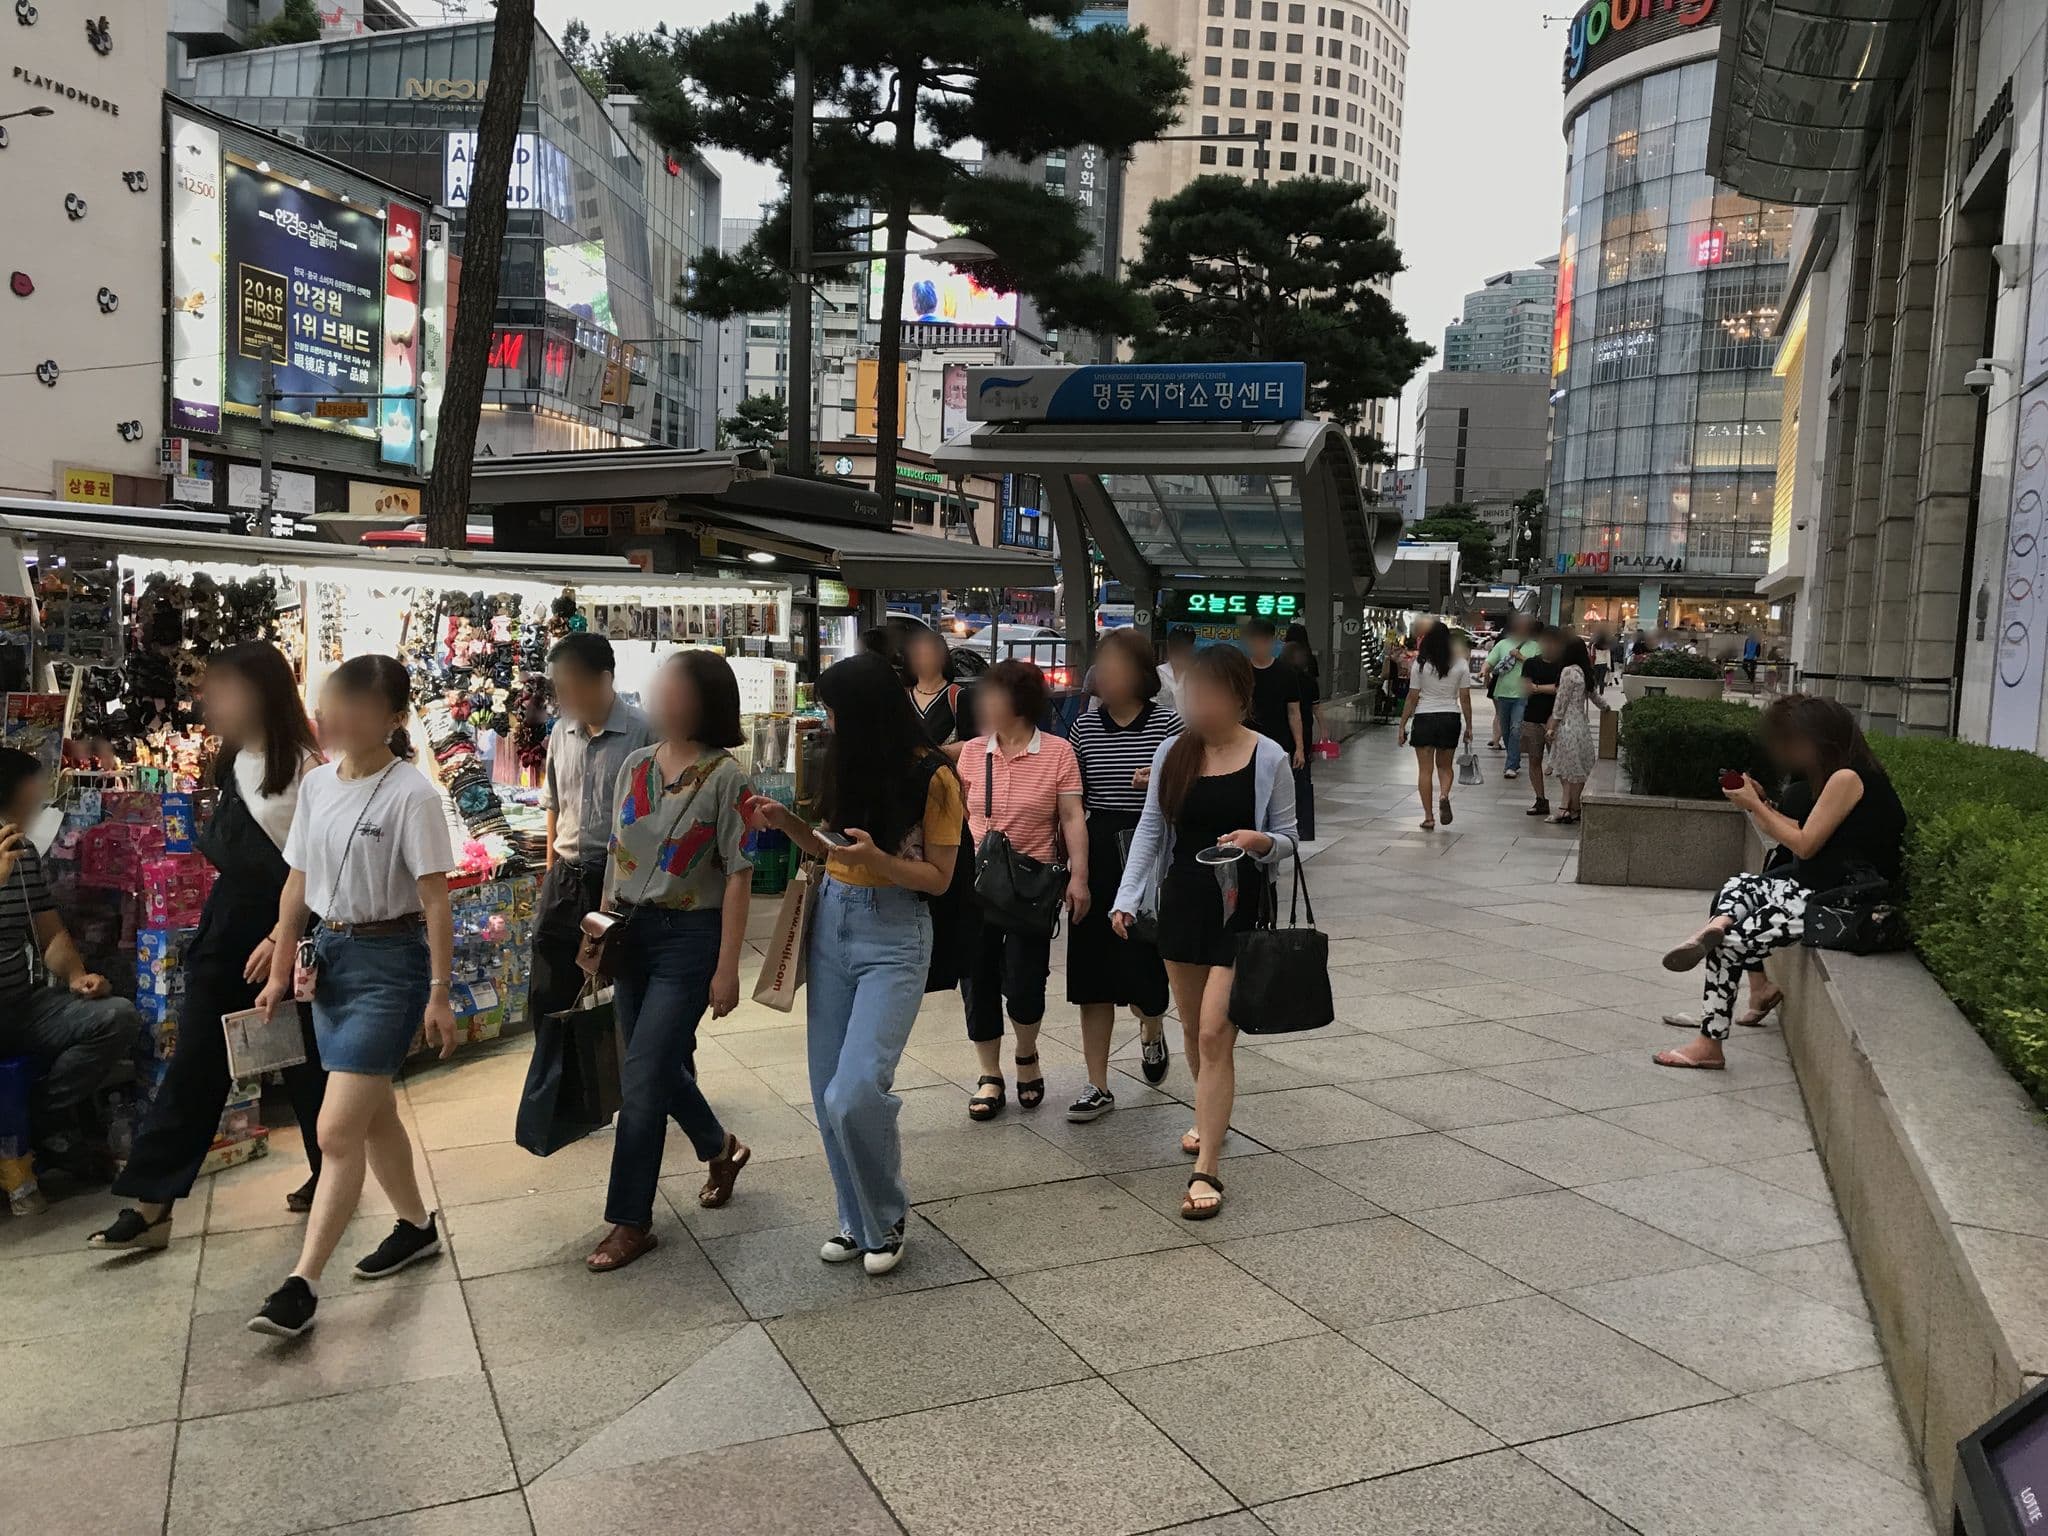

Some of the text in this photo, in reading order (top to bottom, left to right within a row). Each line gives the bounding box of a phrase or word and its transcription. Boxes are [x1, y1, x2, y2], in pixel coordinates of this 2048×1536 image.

[13, 66, 119, 116] PLAYNOMORE
[431, 104, 477, 113] SQUARE
[275, 208, 309, 240] 안경은
[244, 278, 283, 304] 2018
[293, 280, 342, 317] 안경원
[244, 297, 283, 322] FIRST
[293, 312, 370, 352] 1위 브랜드
[1093, 382, 1284, 410] 명동지하쇼핑센터
[1704, 424, 1767, 437] ZARA
[69, 478, 111, 498] 상품권
[1557, 552, 1609, 574] young
[1613, 555, 1665, 567] PLAZA
[1188, 594, 1295, 615] 오늘도 좋은
[1137, 613, 1148, 622] 17
[1345, 622, 1358, 631] 17
[2020, 1487, 2043, 1524] LOTTE
